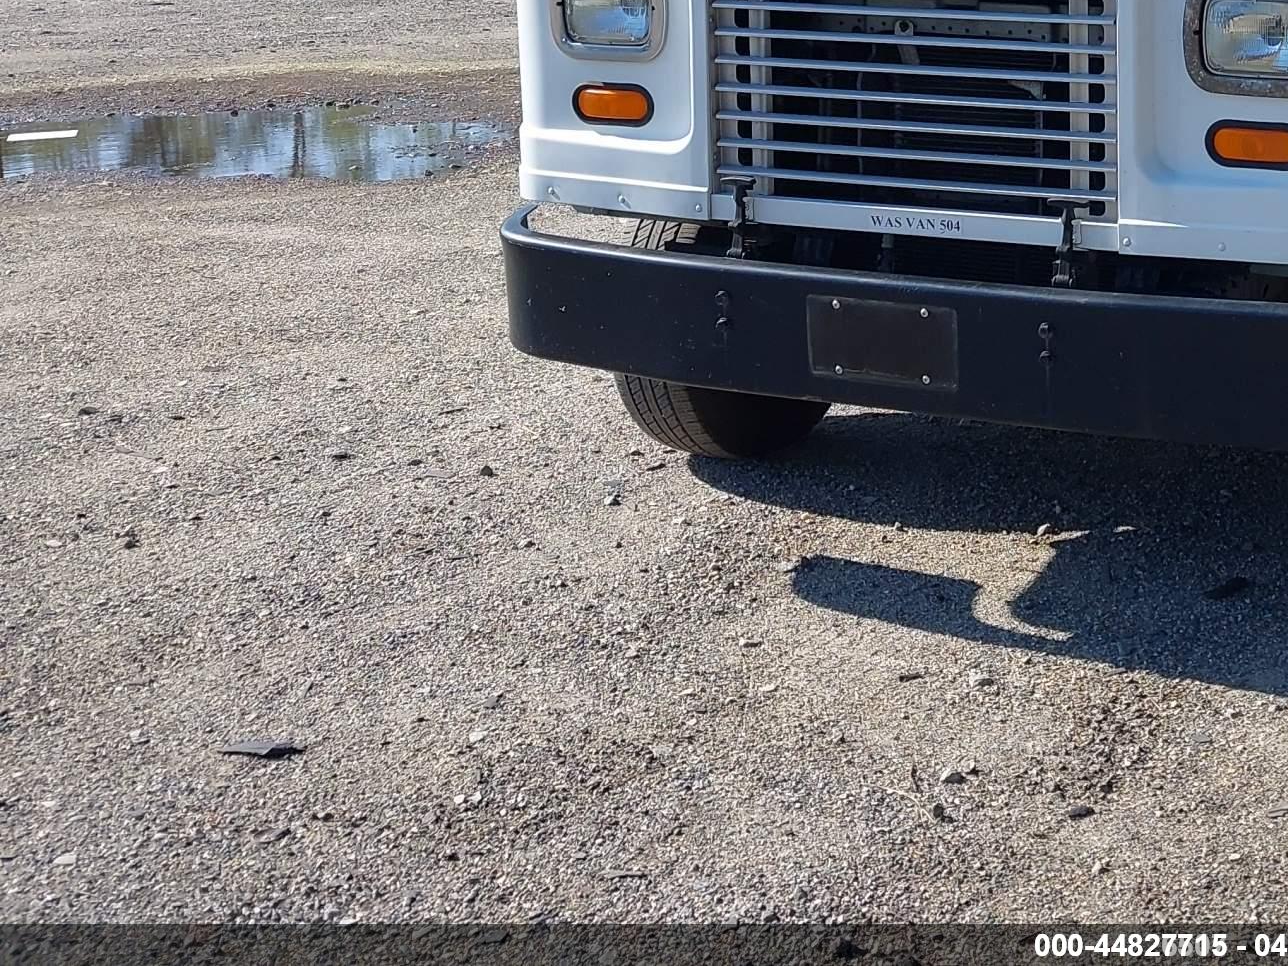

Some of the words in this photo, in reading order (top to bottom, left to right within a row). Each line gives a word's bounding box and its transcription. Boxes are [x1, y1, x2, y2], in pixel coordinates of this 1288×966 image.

[871, 215, 902, 228] WAS
[906, 217, 936, 230] VAN
[940, 219, 961, 232] 504
